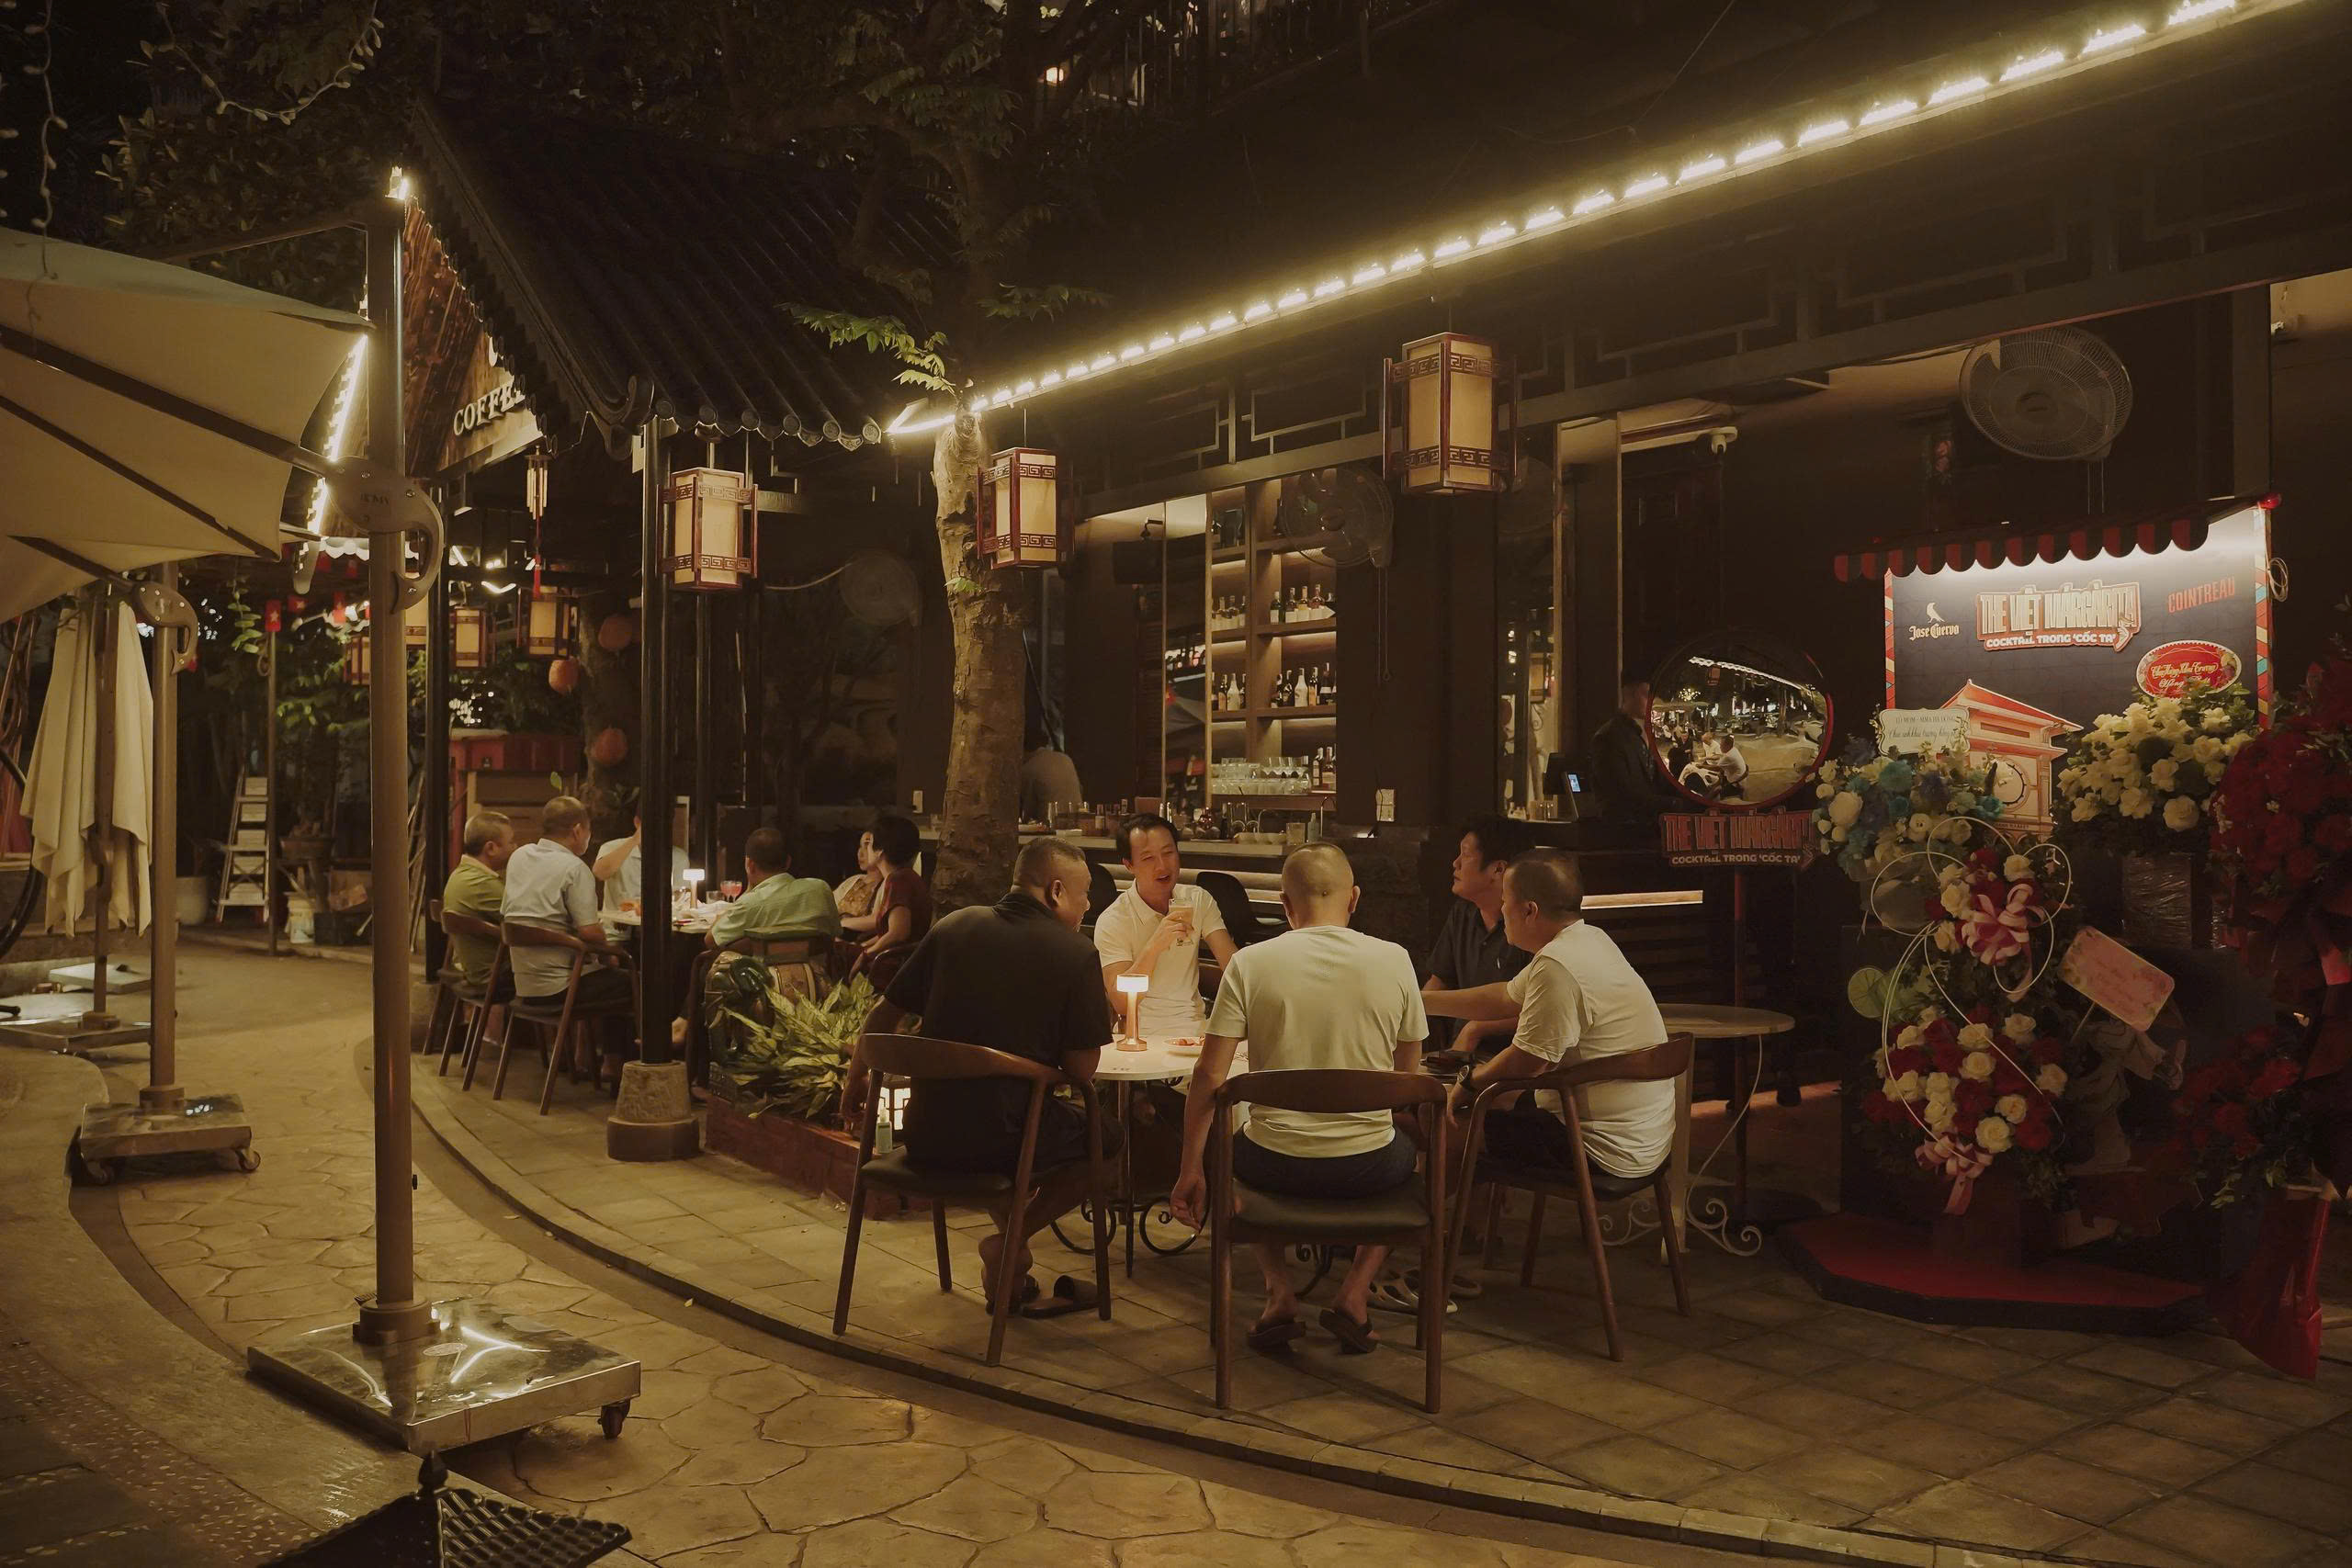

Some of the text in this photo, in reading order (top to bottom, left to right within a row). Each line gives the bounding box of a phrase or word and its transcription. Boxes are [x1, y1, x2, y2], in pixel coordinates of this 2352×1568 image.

[2168, 575, 2234, 613] COINTREAU
[1980, 594, 2007, 634] THE
[1908, 623, 1960, 641] Jose Cuervo
[1985, 635, 2036, 648] COCKTAIL
[2036, 634, 2072, 644] TRONG
[1664, 815, 1691, 852] THE
[1672, 853, 1721, 864] COCKTAIL
[1722, 853, 1757, 863] TRONG
